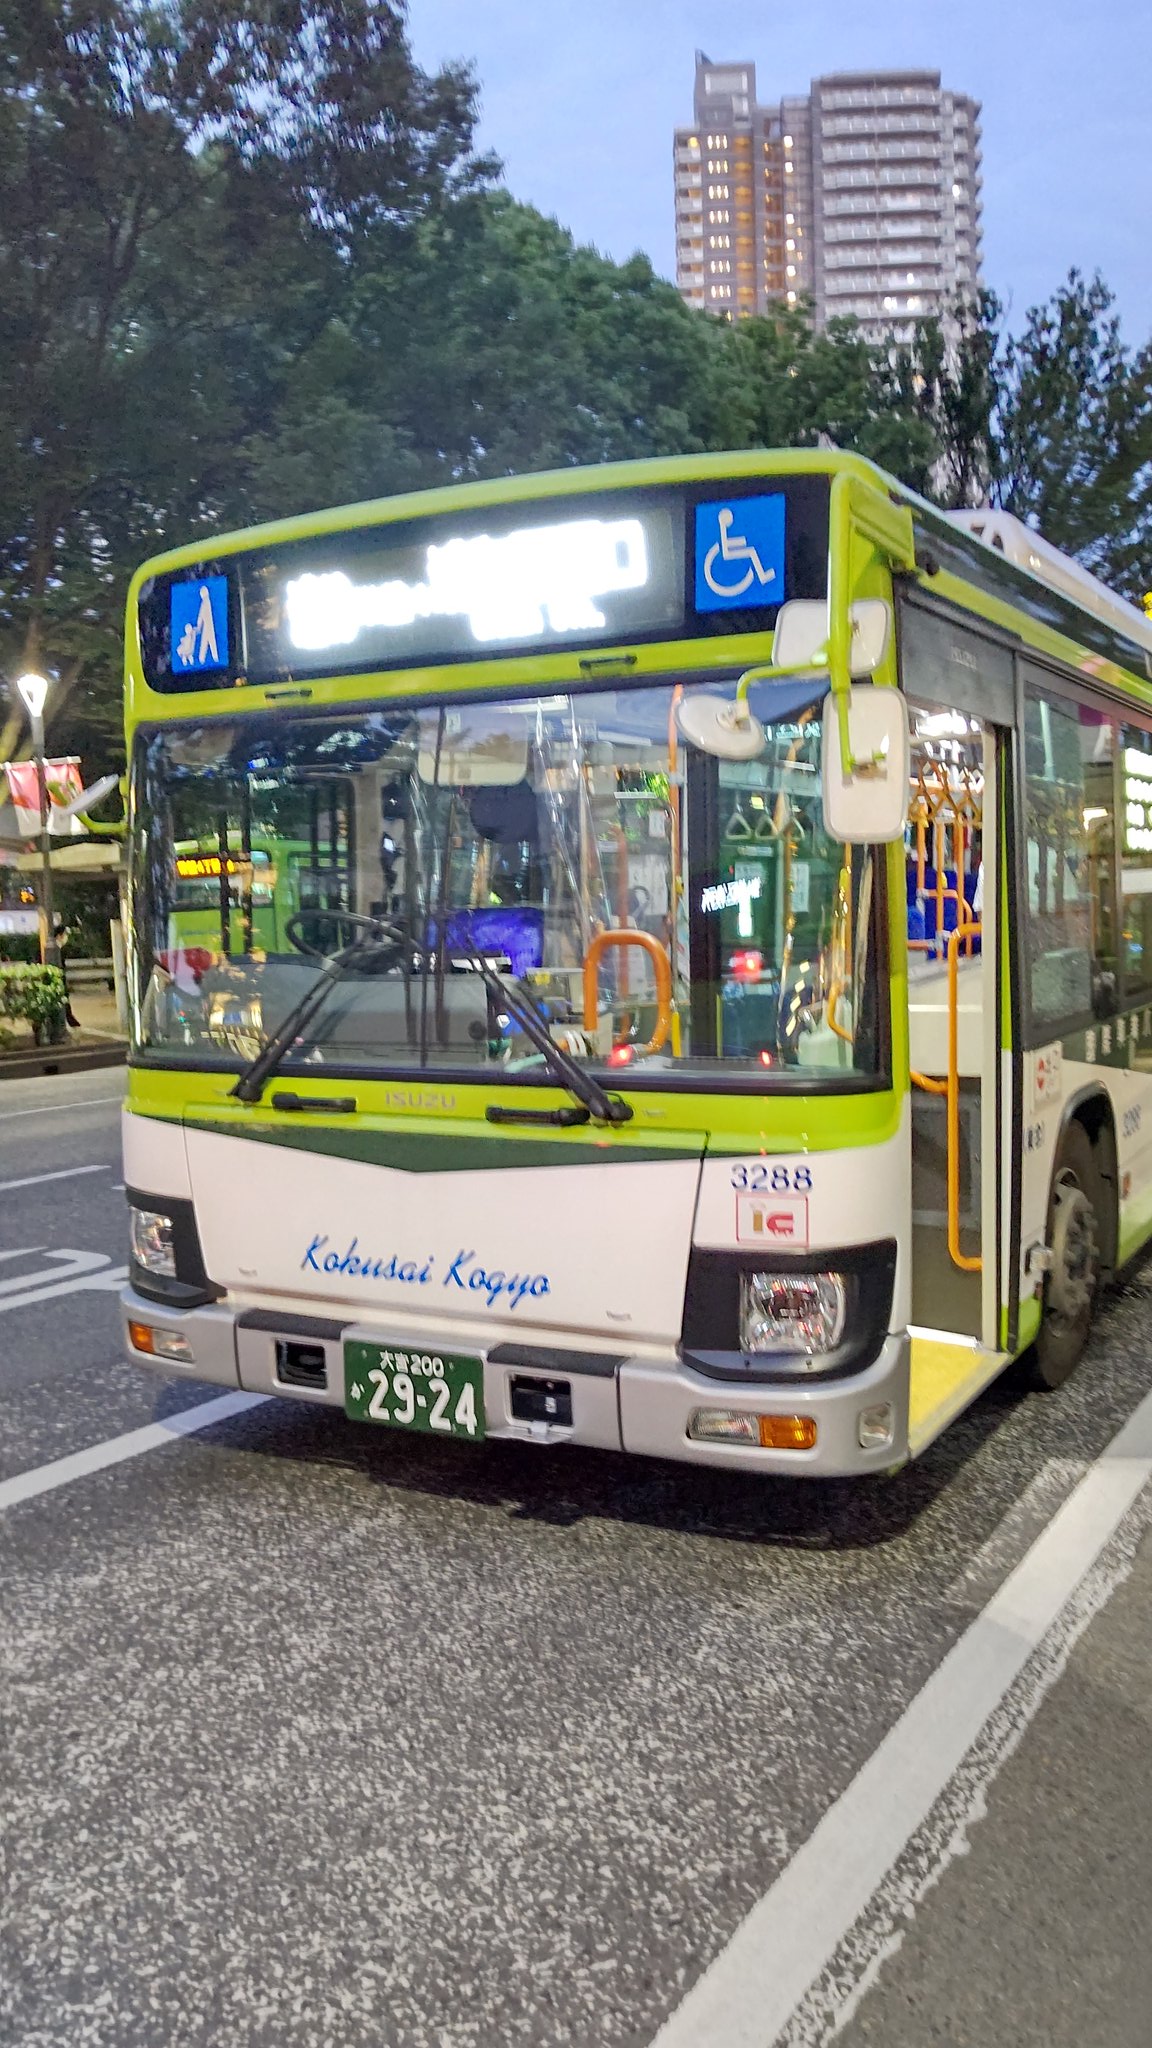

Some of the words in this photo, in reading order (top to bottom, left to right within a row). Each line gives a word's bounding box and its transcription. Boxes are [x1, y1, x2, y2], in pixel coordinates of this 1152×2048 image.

[731, 1163, 813, 1193] 3288
[300, 1234, 434, 1285] Kokusai
[443, 1248, 551, 1311] Kogyo
